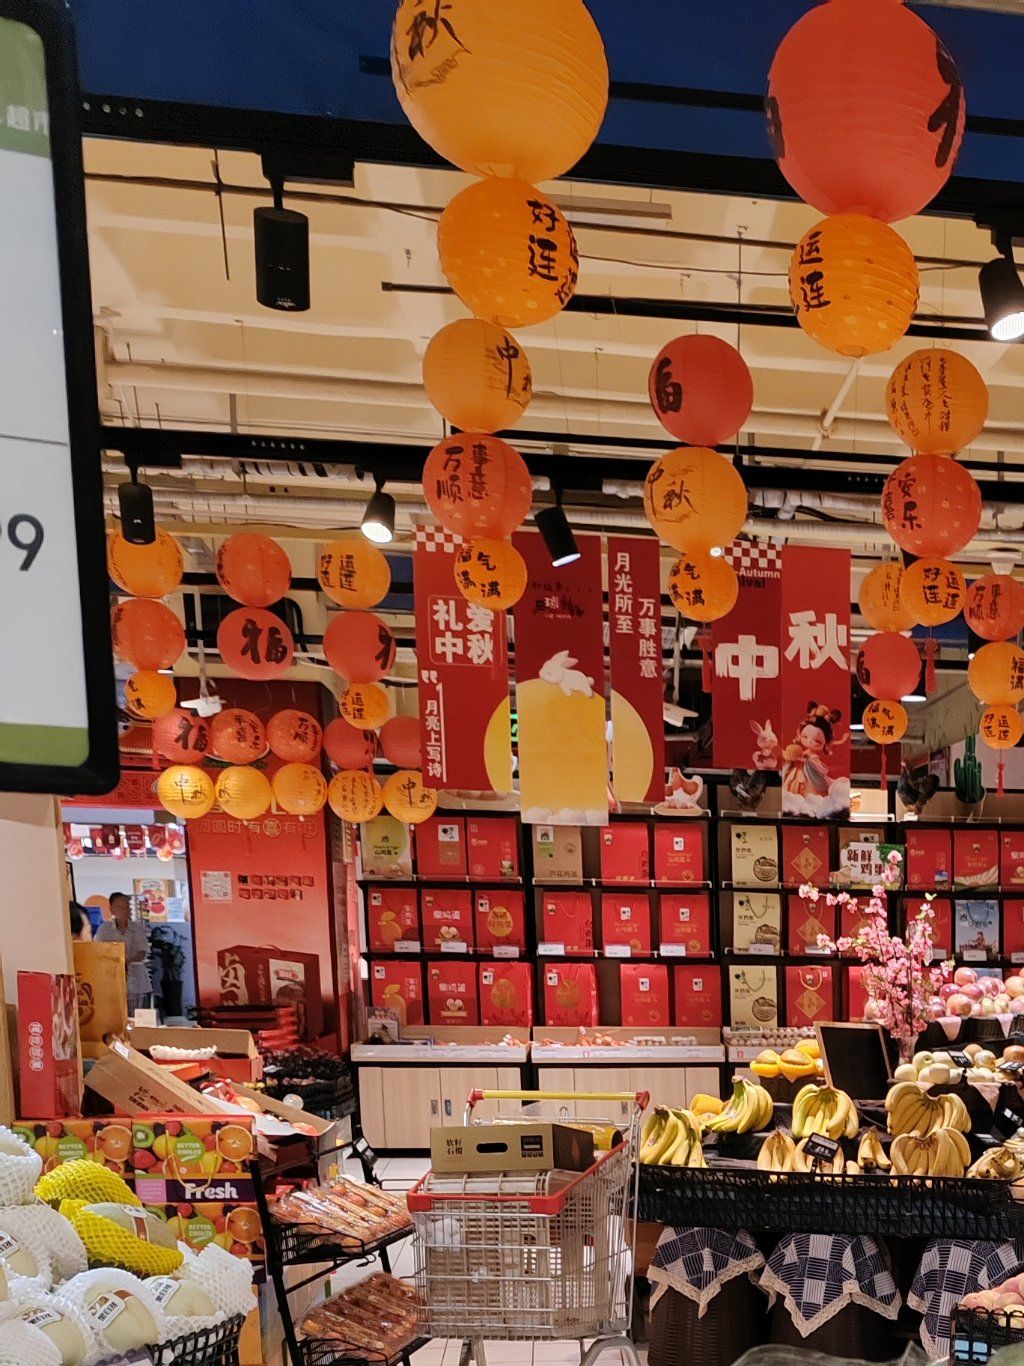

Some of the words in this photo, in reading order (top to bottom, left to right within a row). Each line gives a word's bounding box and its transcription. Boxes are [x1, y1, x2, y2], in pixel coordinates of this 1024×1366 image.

[614, 552, 635, 634] 月光所至
[637, 598, 658, 678] 万事胜意
[714, 634, 780, 701] 中
[784, 610, 849, 670] 秋
[184, 1182, 239, 1200] Fresh
